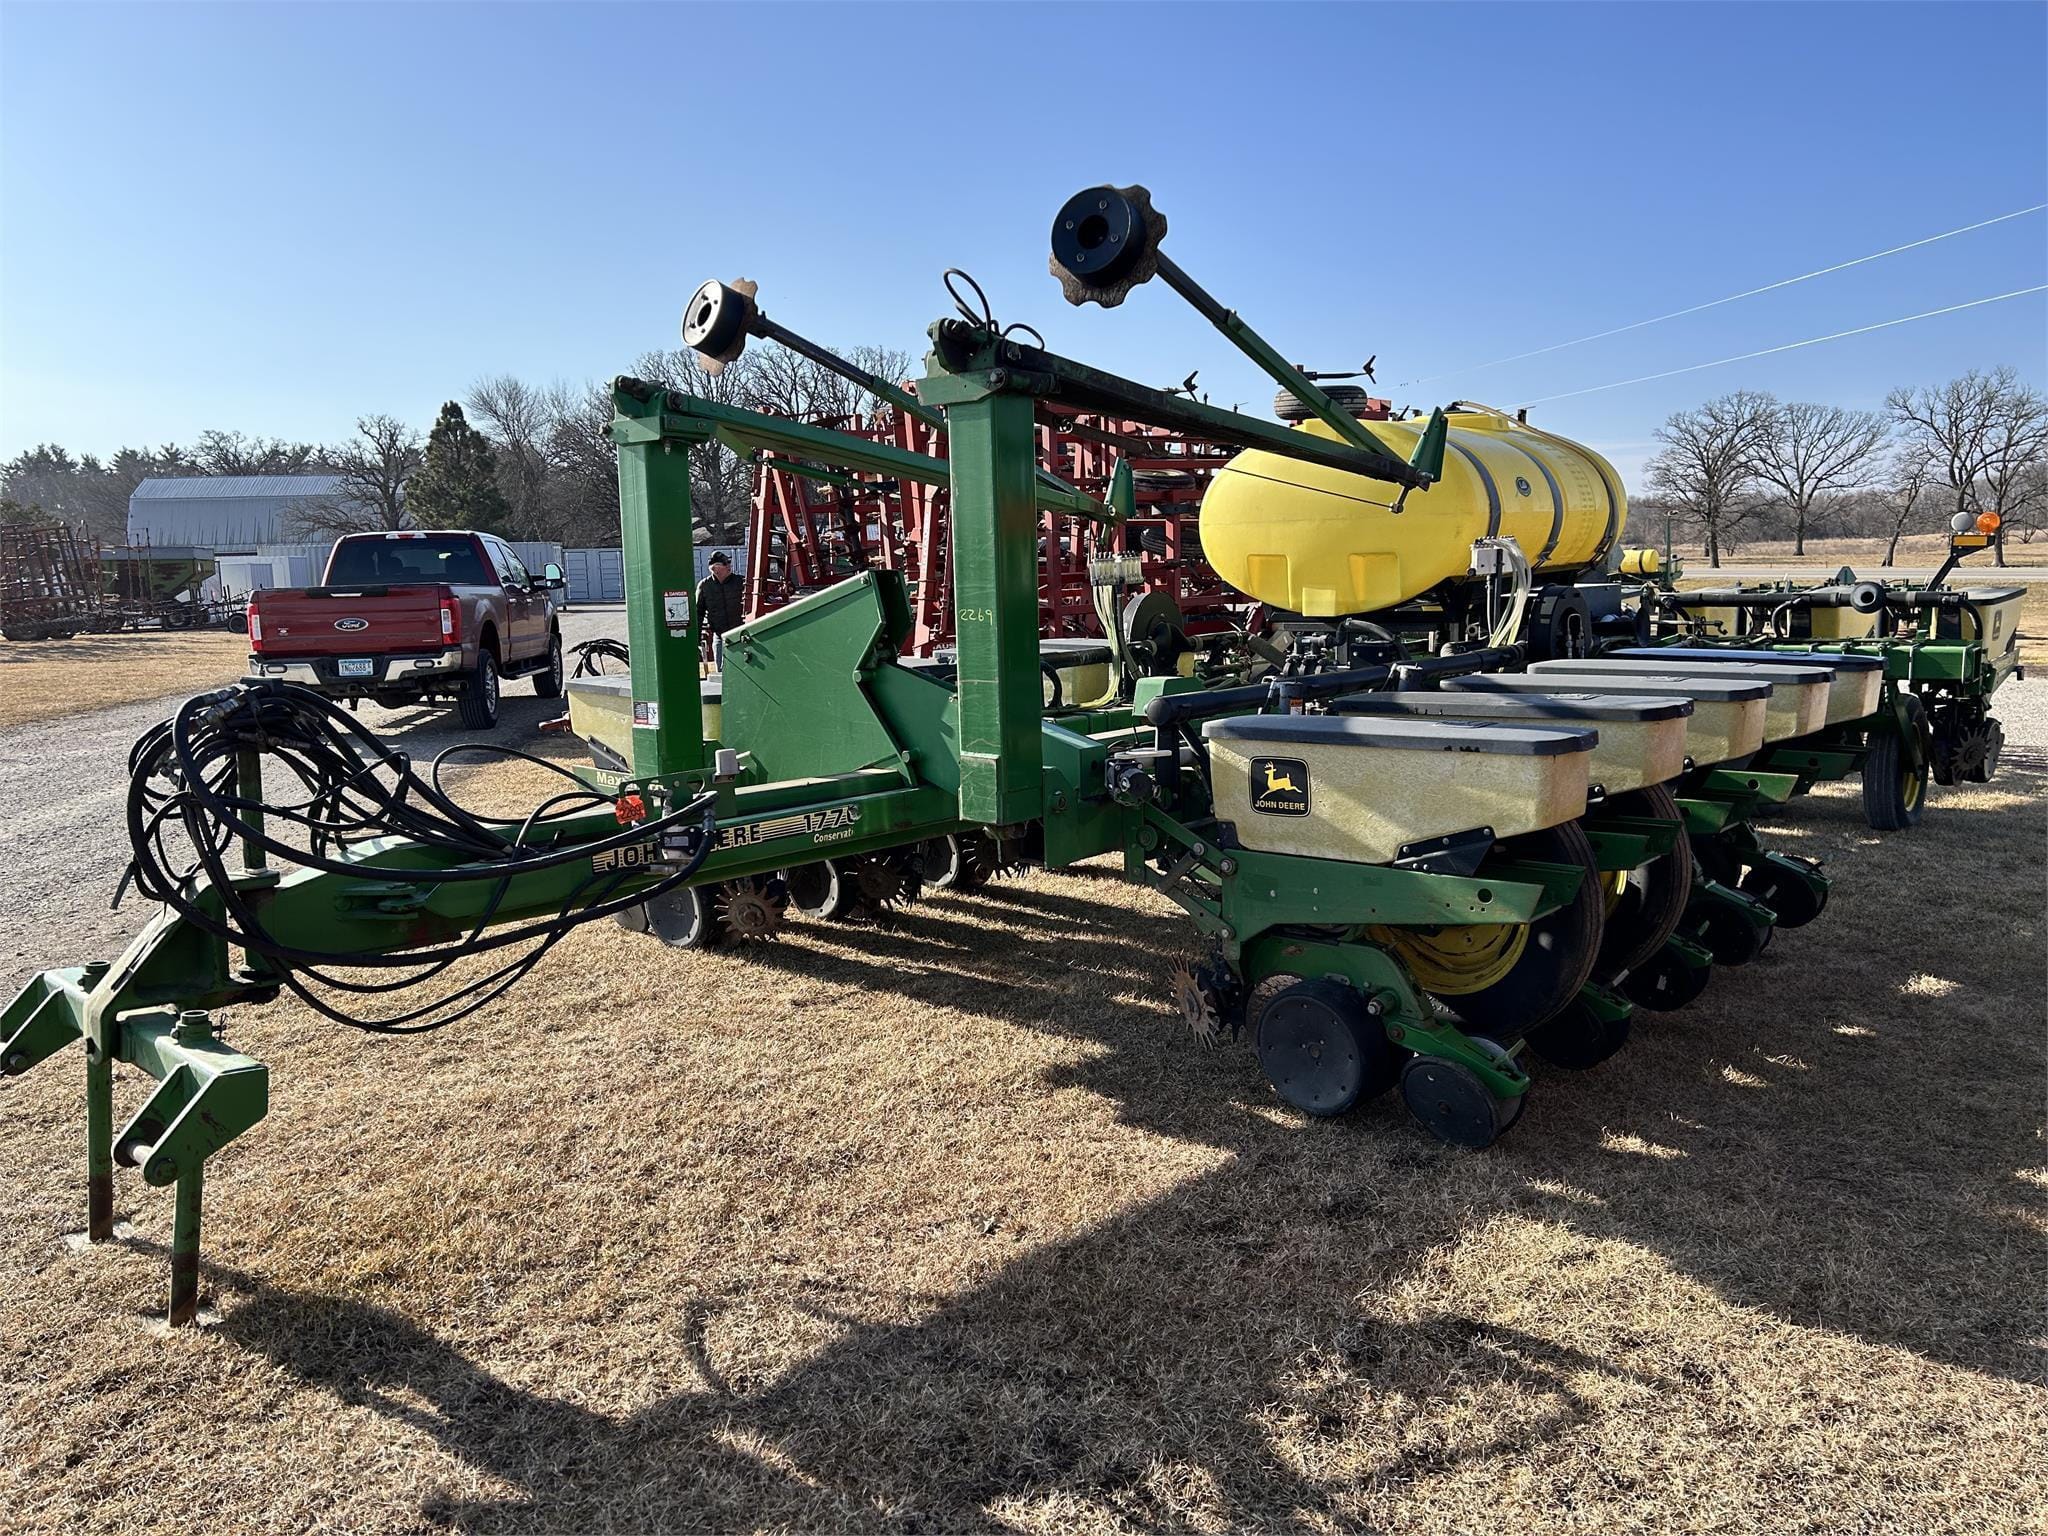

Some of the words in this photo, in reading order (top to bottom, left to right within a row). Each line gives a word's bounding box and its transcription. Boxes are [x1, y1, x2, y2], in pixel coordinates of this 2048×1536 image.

[959, 608, 993, 626] 2269
[1255, 800, 1277, 808] JOHN
[1278, 802, 1305, 810] DEERE
[605, 842, 659, 870] JOH
[711, 823, 762, 851] ERE
